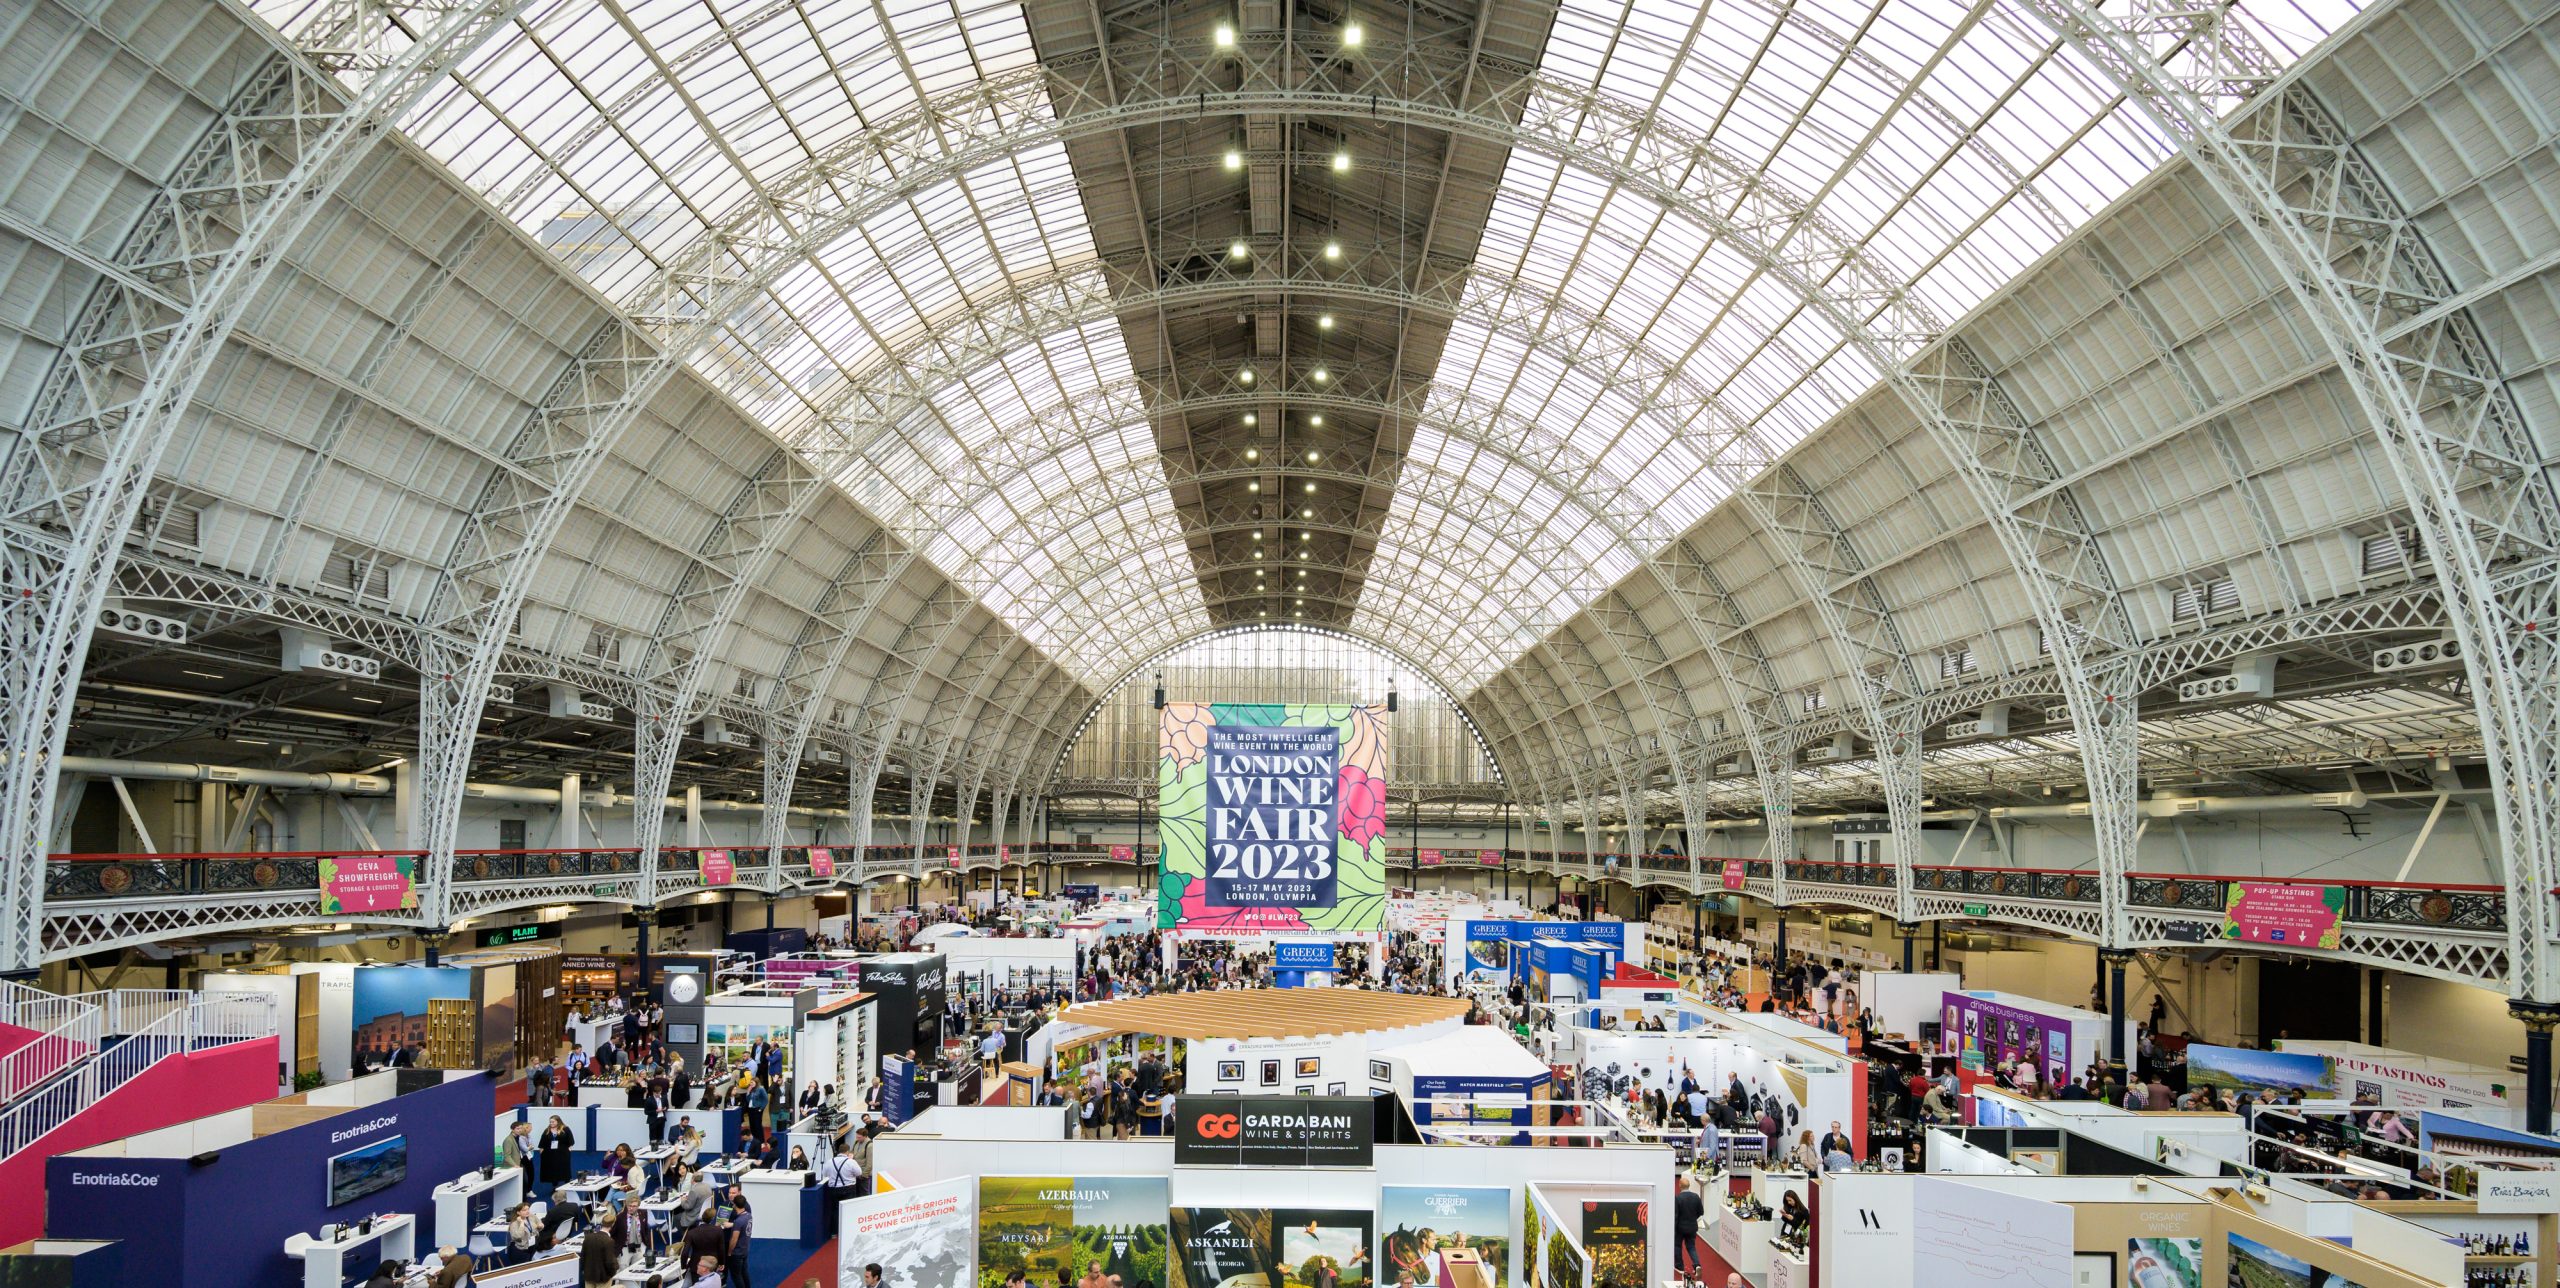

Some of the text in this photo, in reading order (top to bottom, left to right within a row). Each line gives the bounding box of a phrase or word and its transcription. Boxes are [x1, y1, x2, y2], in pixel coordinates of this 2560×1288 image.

[1214, 733, 1333, 742] THE MOST INTELLIGENT
[1214, 742, 1333, 751] WINE EVENT IN THE WORLD
[1213, 755, 1333, 775] LONDON
[1213, 776, 1333, 805] WINE
[1213, 808, 1332, 841] FAIR
[357, 862, 379, 871] CEVA
[1212, 843, 1332, 880] 2023
[338, 872, 398, 883] SHOWFREIGHT
[340, 885, 365, 893] STORAGE
[372, 884, 399, 892] LOGISTICS
[1231, 884, 1311, 892] 15-17 MAY 2023
[2254, 887, 2315, 897] POP-UP TASTINGS
[1226, 893, 1317, 901] LONDON, OLYMPIA
[513, 926, 538, 937] PLANT
[1205, 928, 1261, 936] GEORGIA
[1474, 925, 1508, 933] GREECE
[1533, 927, 1567, 935] GREECE
[1584, 926, 1617, 934] GREECE
[1283, 947, 1327, 957] GREECE
[1970, 1000, 2035, 1023] drinks business
[2372, 1063, 2447, 1089] TASTINGS
[2450, 1084, 2471, 1096] STAND
[1197, 1113, 1351, 1139] GG GARDABANI
[1245, 1131, 1279, 1139] WINE
[1300, 1131, 1351, 1139] SPIRITS
[1038, 1190, 1110, 1202] AZERBAIJAN
[1424, 1197, 1467, 1206] GUERRIERI
[858, 1196, 958, 1224] DISCOVER THE ORIGINS
[860, 1205, 956, 1233] OF WINE CIVILISATION
[2140, 1212, 2189, 1222] ORGANIC
[2148, 1223, 2180, 1232] WINES
[1001, 1234, 1050, 1243] MEYSARI
[1185, 1237, 1254, 1248] ASKANELI
